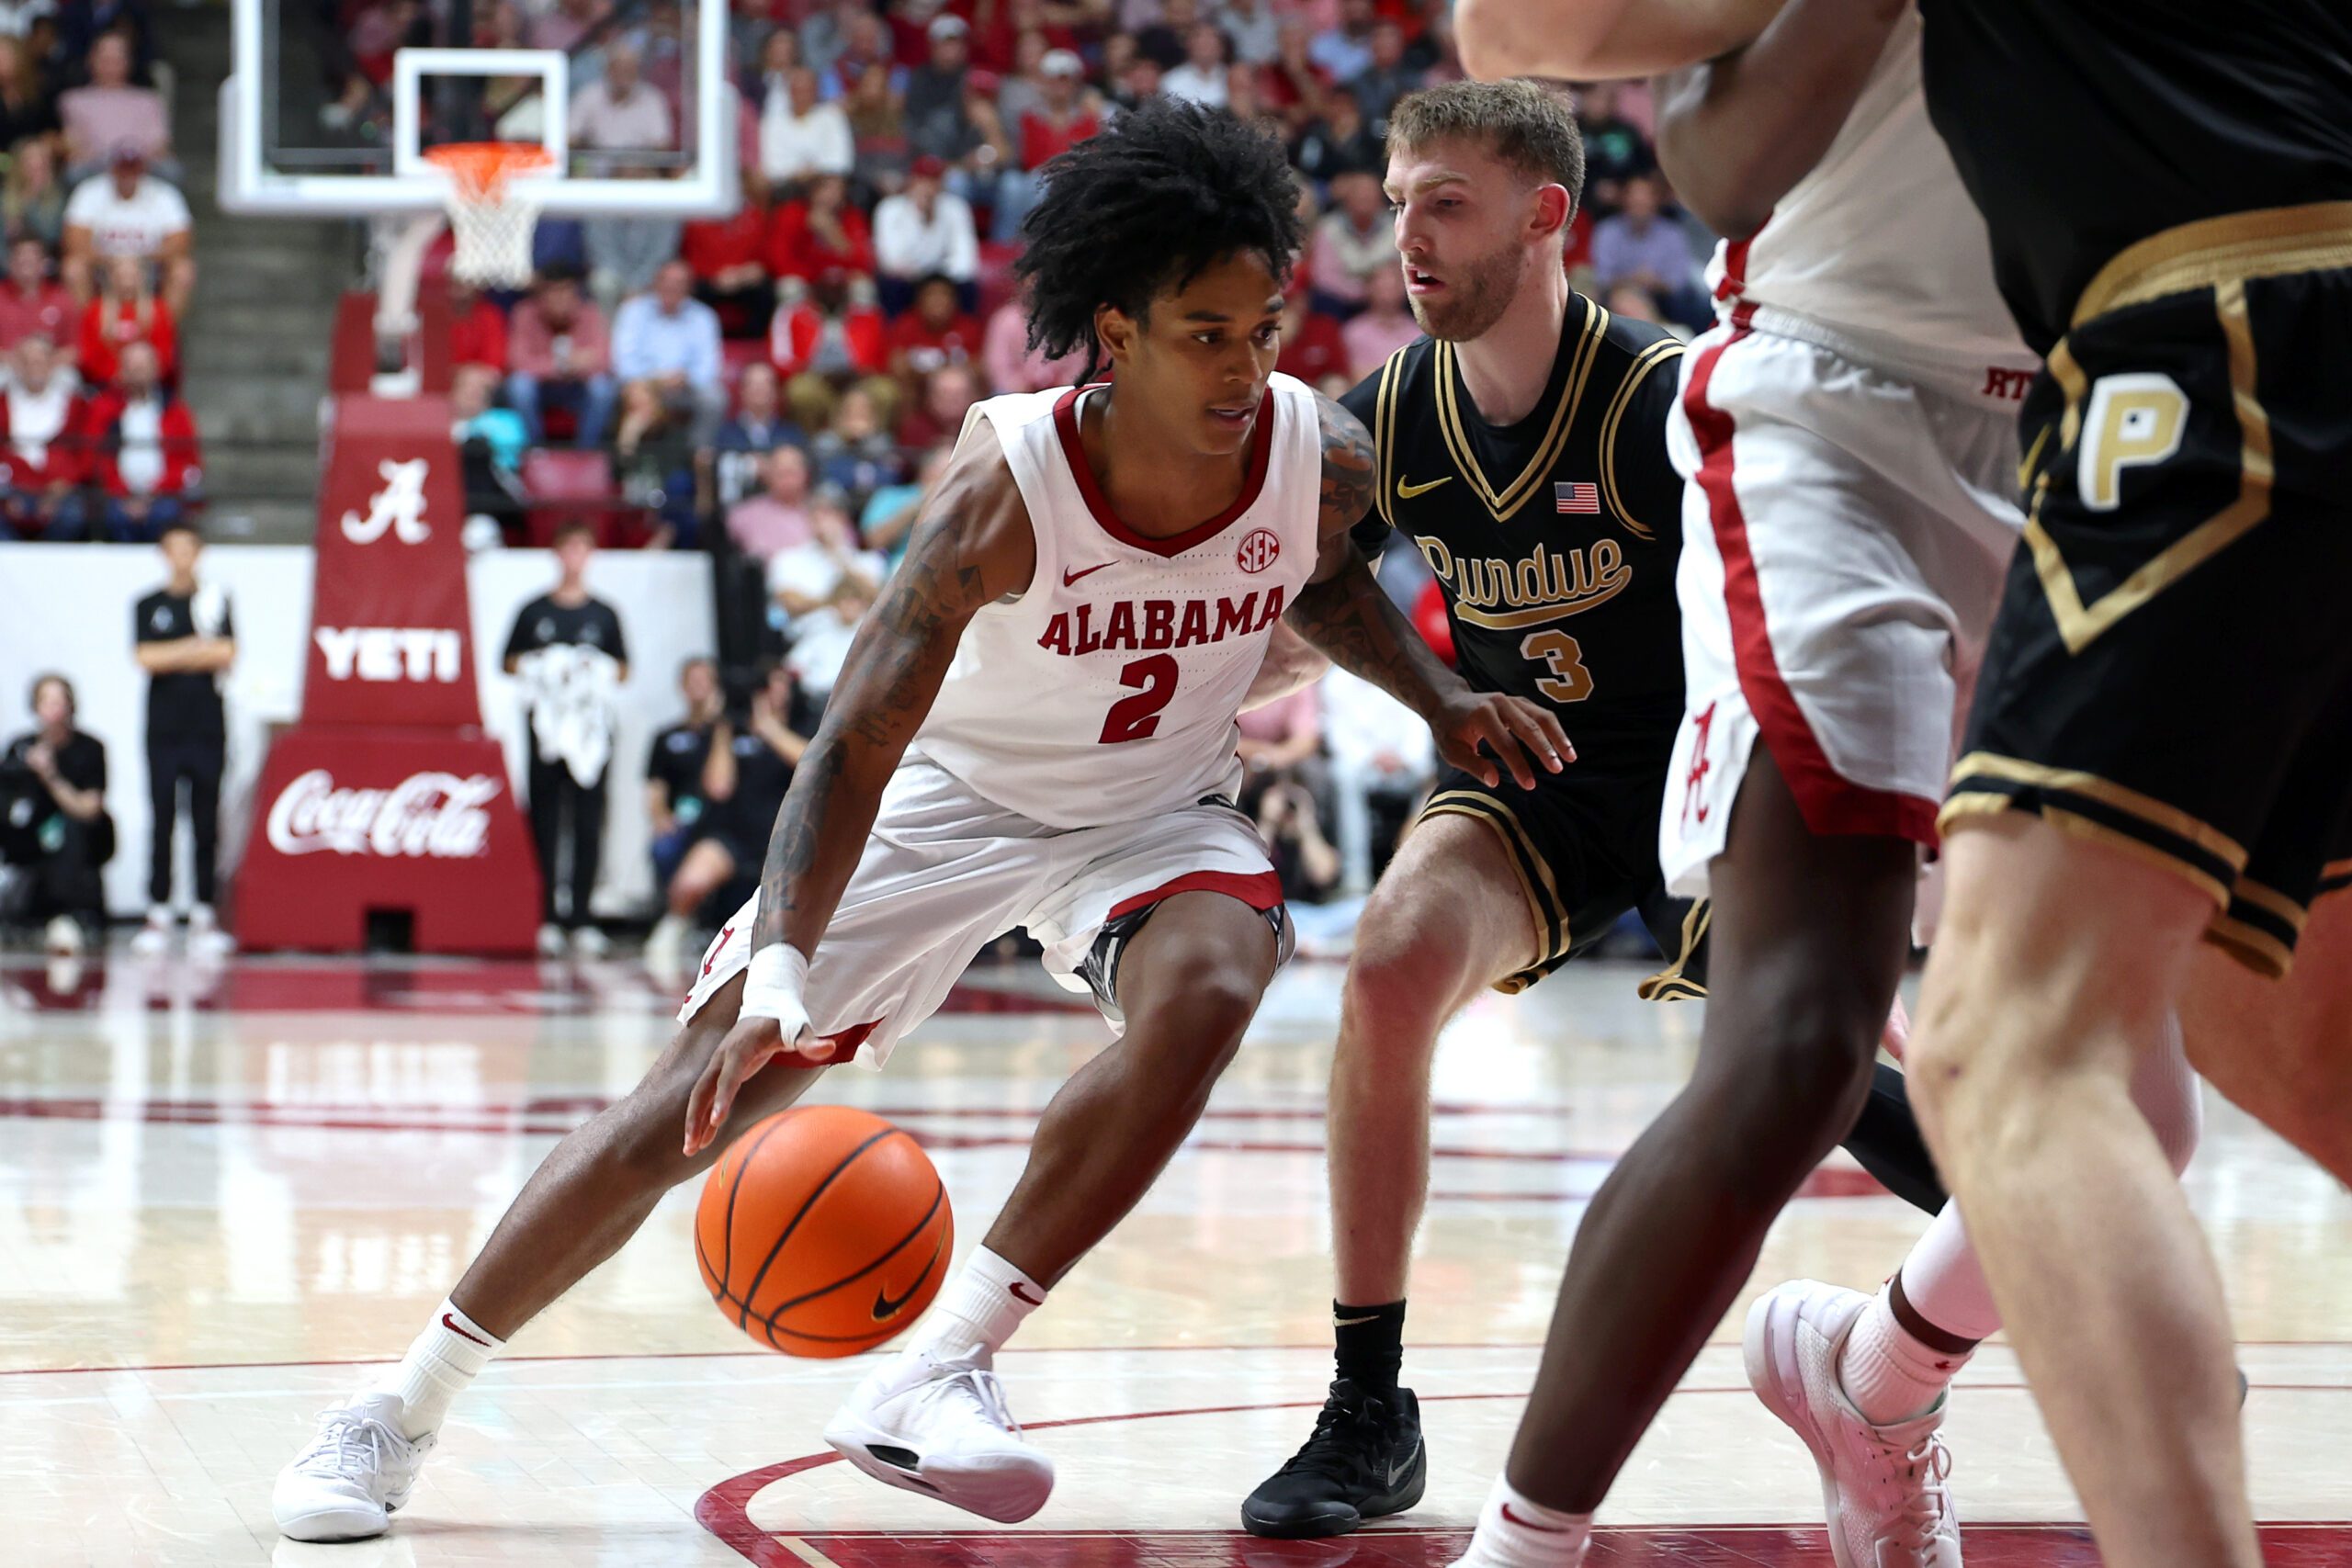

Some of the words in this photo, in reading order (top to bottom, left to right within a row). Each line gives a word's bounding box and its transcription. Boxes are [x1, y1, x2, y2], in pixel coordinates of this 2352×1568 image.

[2077, 372, 2190, 513] P
[1237, 529, 1280, 574] SEC
[1414, 535, 1632, 630] Purdue
[315, 626, 461, 683] YETI
[1037, 585, 1284, 656] ALABAMA
[1098, 653, 1179, 744] 2
[1519, 629, 1594, 703] 3
